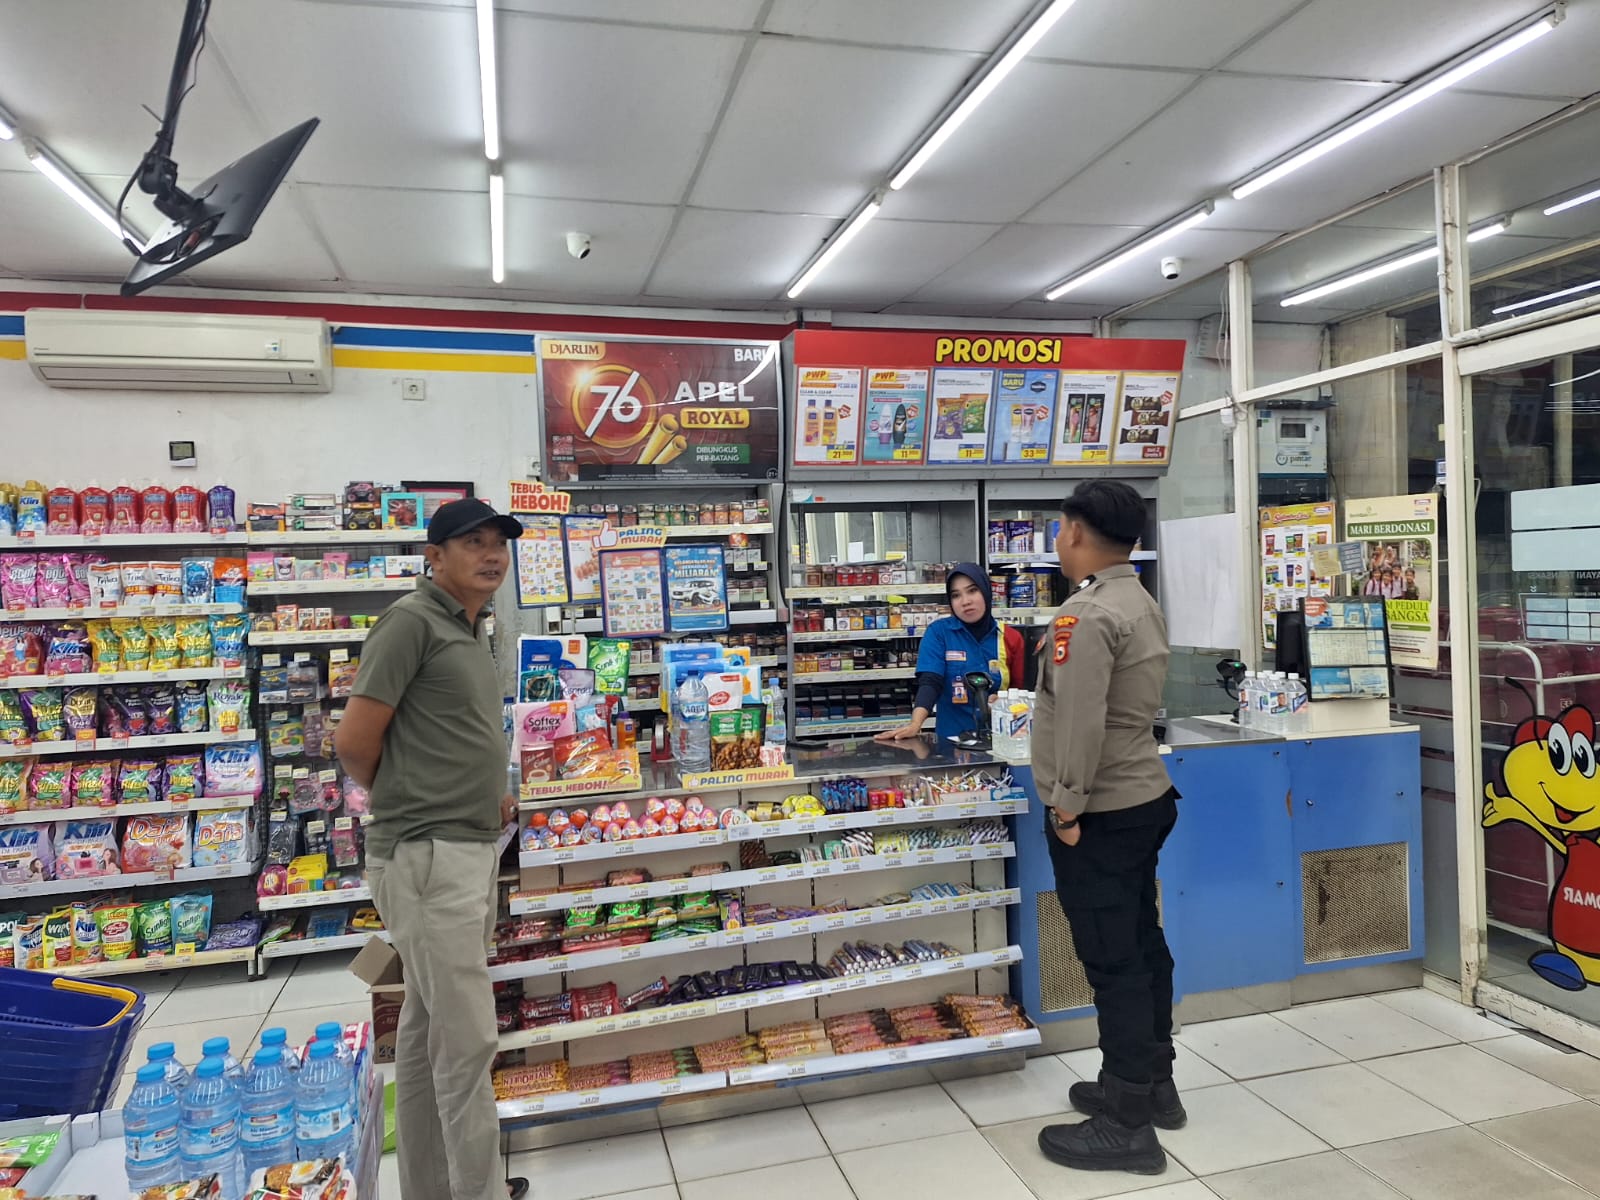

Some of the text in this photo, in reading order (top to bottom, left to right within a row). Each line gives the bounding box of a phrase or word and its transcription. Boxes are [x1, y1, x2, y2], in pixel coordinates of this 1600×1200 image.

[550, 344, 599, 355] DJARUM
[935, 337, 1062, 364] PROMOSI
[805, 370, 827, 379] PWP
[874, 371, 895, 380] PWP
[674, 381, 755, 402] APEL
[584, 370, 642, 438] 76
[687, 410, 744, 425] ROYAL
[696, 446, 738, 454] DIBUNGKUS
[511, 482, 542, 494] TEBUS
[511, 495, 568, 512] HEBOH!
[619, 528, 662, 538] PALING
[1350, 522, 1430, 535] MARI BERDONASI
[621, 536, 662, 545] MURAH
[1396, 601, 1428, 611] PEDULI
[528, 716, 561, 727] Softex
[700, 770, 789, 785] PALING MURAH
[530, 780, 609, 796] TEBUS HEBOH!
[63, 822, 114, 840] Klin
[199, 822, 244, 847] Daia
